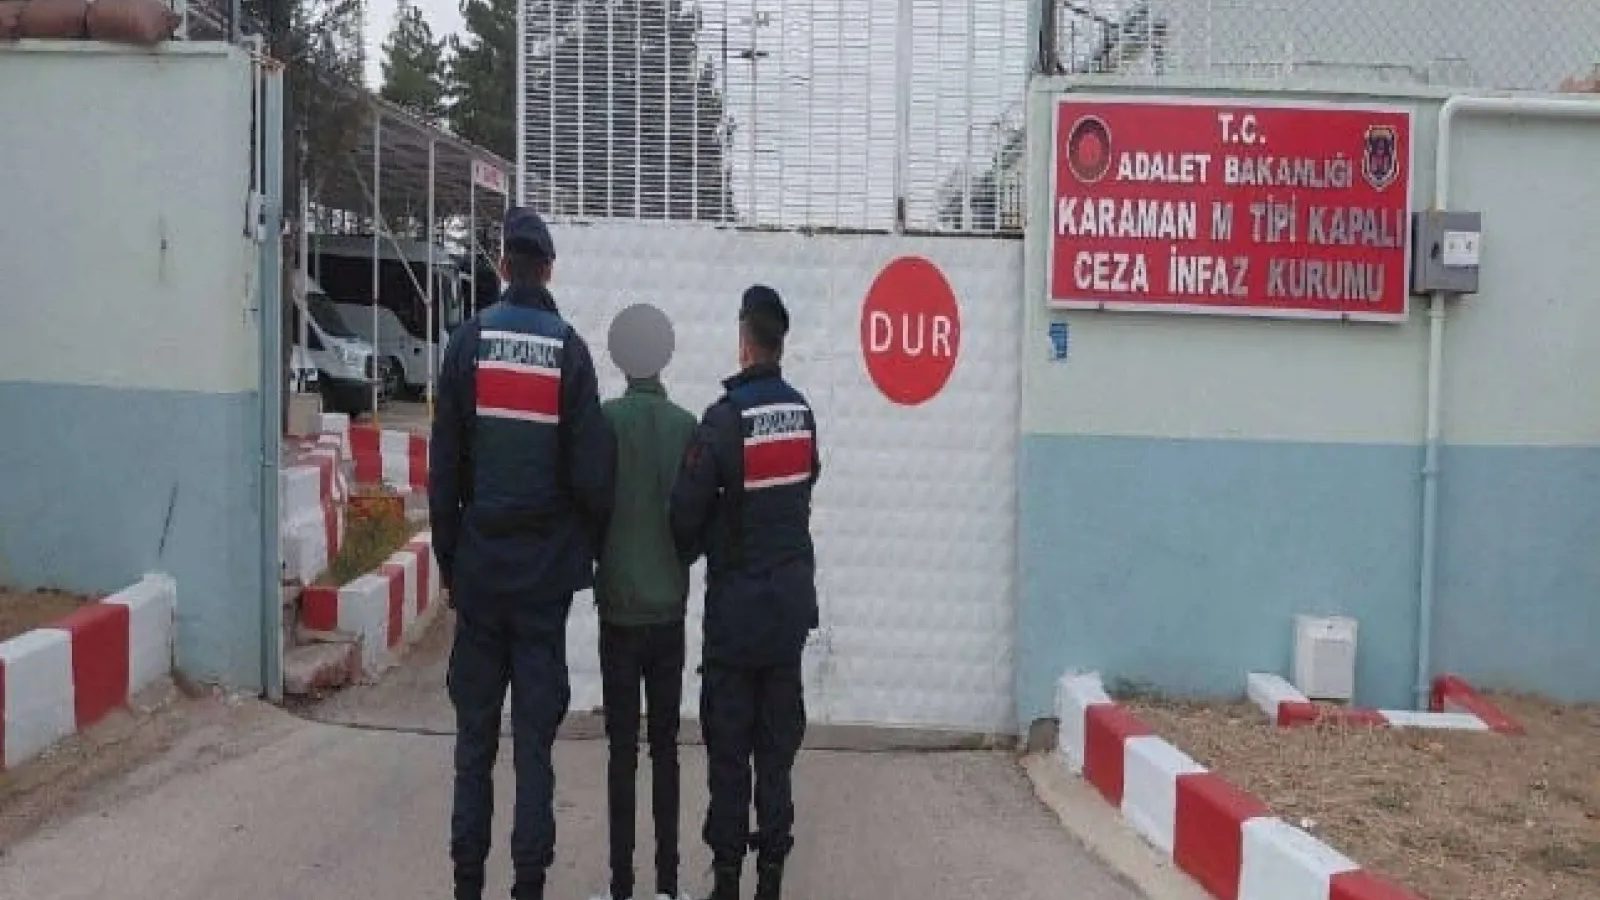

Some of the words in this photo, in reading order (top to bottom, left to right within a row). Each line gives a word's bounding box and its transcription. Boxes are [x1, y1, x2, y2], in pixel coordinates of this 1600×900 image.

[1217, 112, 1267, 144] T.C.
[1116, 151, 1211, 183] ADALET
[1224, 151, 1353, 188] BAKANLIĞI
[1058, 196, 1197, 240] KARAMAN
[1211, 201, 1234, 240] M
[1250, 193, 1296, 243] TİPİ
[1308, 206, 1406, 248] KAPALI
[1074, 251, 1149, 292] CEZA
[1168, 245, 1249, 296] İNFAZ
[1267, 258, 1385, 302] KURUMU
[870, 311, 951, 357] DUR
